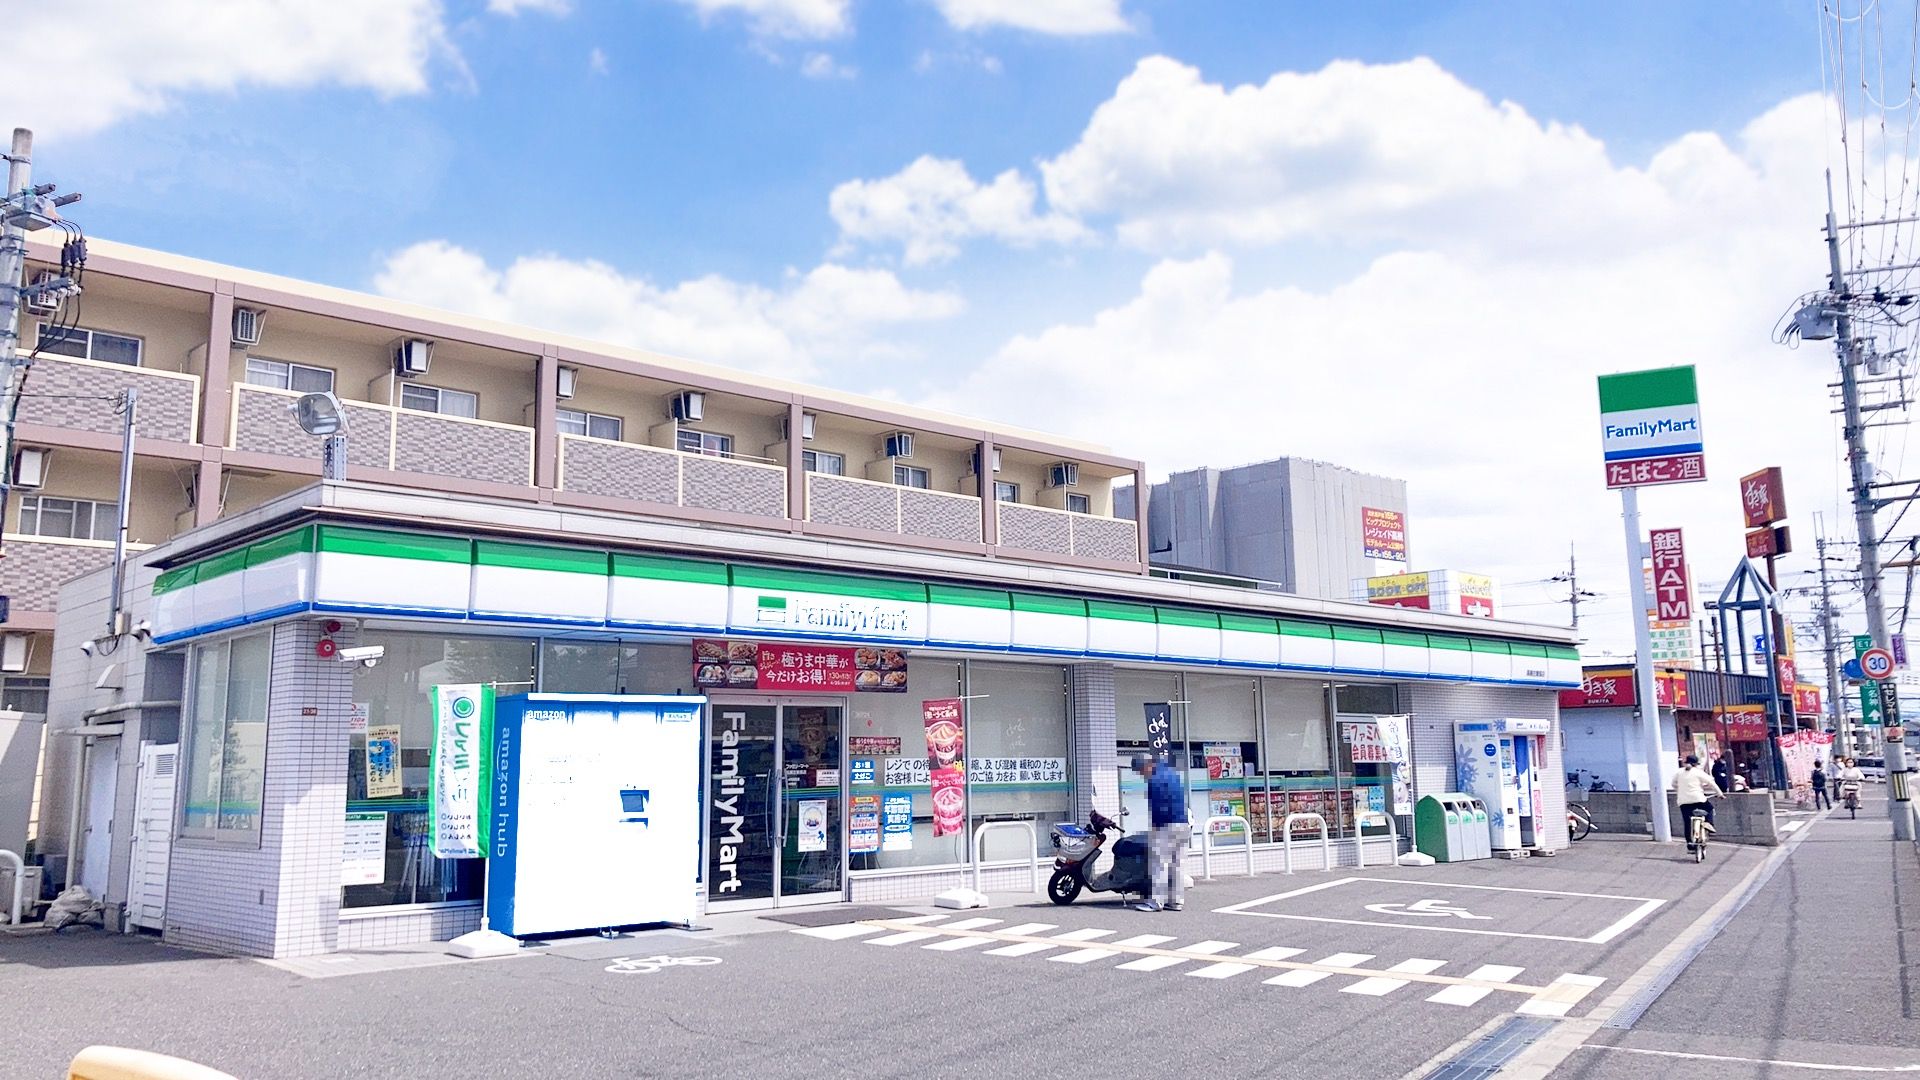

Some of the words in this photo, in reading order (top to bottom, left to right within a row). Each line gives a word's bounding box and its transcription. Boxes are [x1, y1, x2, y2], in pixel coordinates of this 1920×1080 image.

[1606, 418, 1697, 438] FamilyMart
[1610, 457, 1700, 484] たばこ・酒
[1653, 532, 1688, 618] 銀行ATM
[795, 599, 909, 631] FamilyMart
[781, 652, 849, 669] 極うま中華が
[1868, 657, 1887, 670] 30
[766, 669, 826, 685] 今だけお得!
[1580, 673, 1617, 698] すき家
[526, 709, 567, 721] amazon
[1352, 743, 1388, 761] 会員募集中
[498, 727, 511, 807] amazon
[714, 711, 746, 893] FamilyMart
[497, 813, 510, 857] hub
